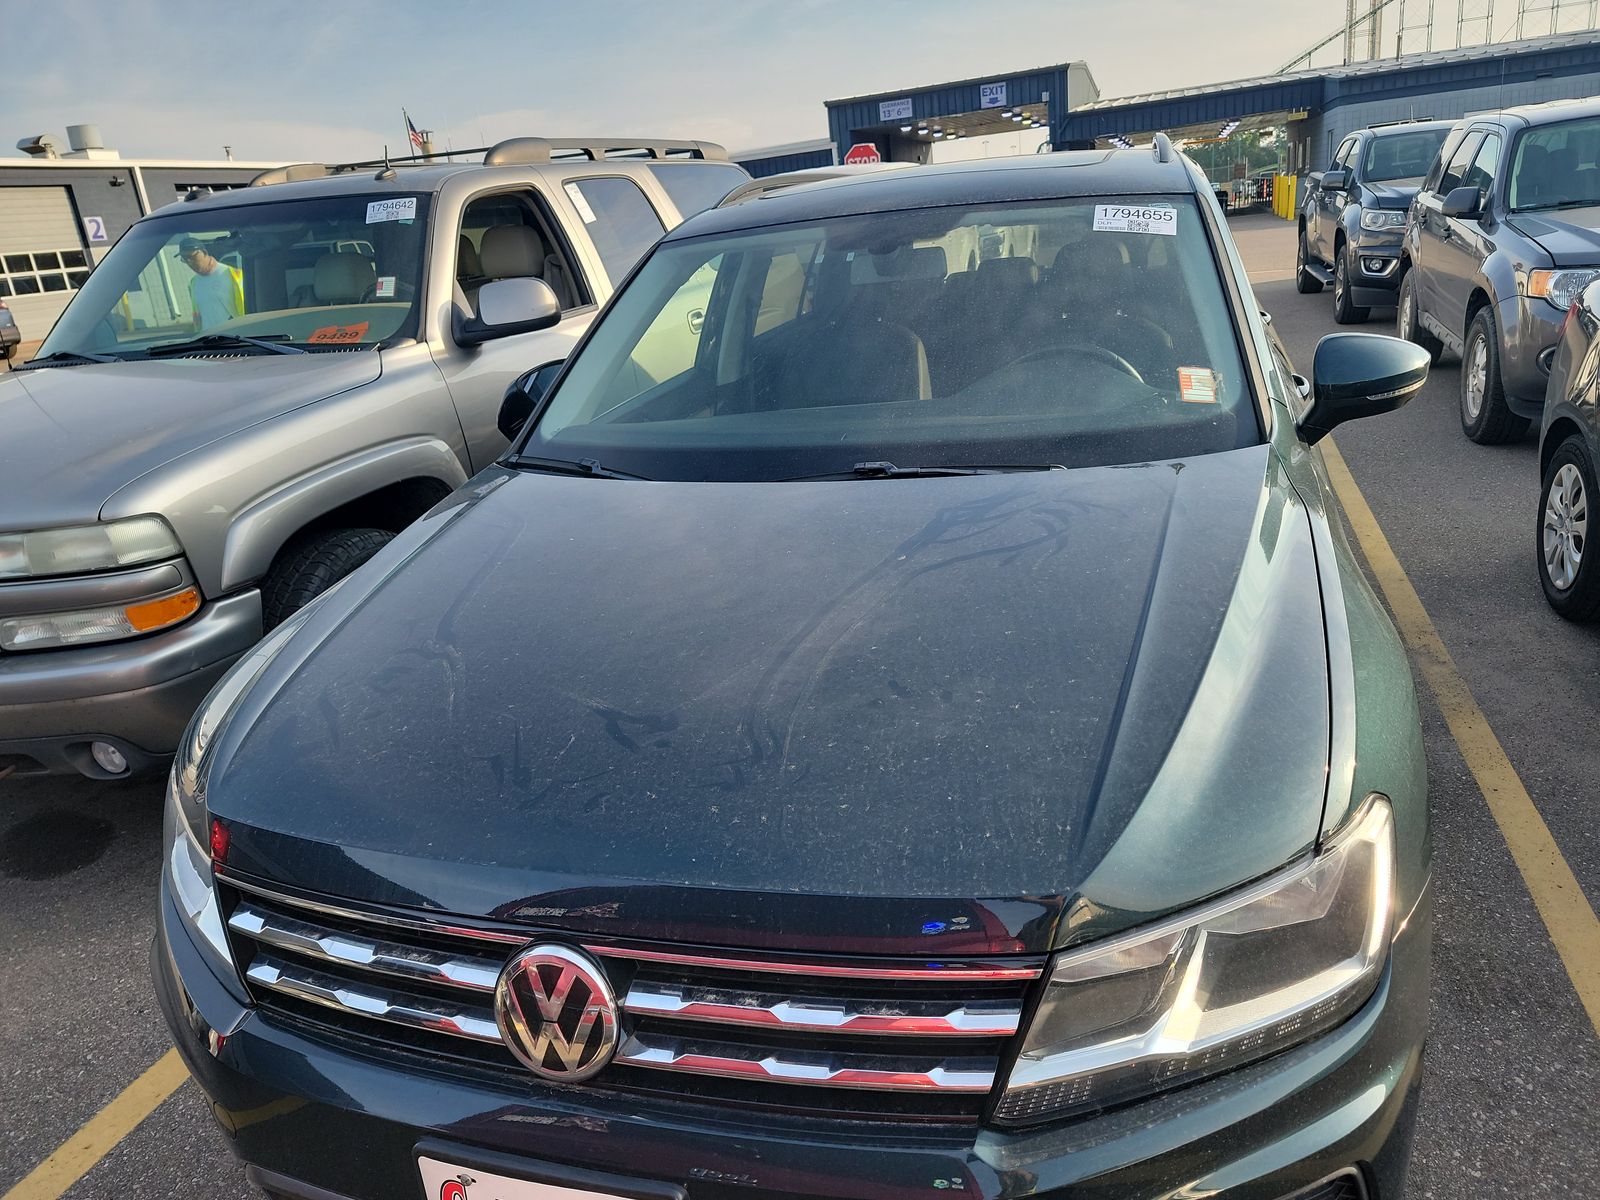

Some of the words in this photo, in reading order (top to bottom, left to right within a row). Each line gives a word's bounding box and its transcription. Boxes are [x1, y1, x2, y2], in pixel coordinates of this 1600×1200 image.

[981, 84, 1005, 97] EXIT
[881, 100, 910, 108] CLEARANCE
[882, 109, 891, 118] 13
[896, 108, 902, 116] 6
[371, 200, 414, 213] 1794642
[1101, 207, 1173, 222] 1794655
[88, 218, 105, 240] 2
